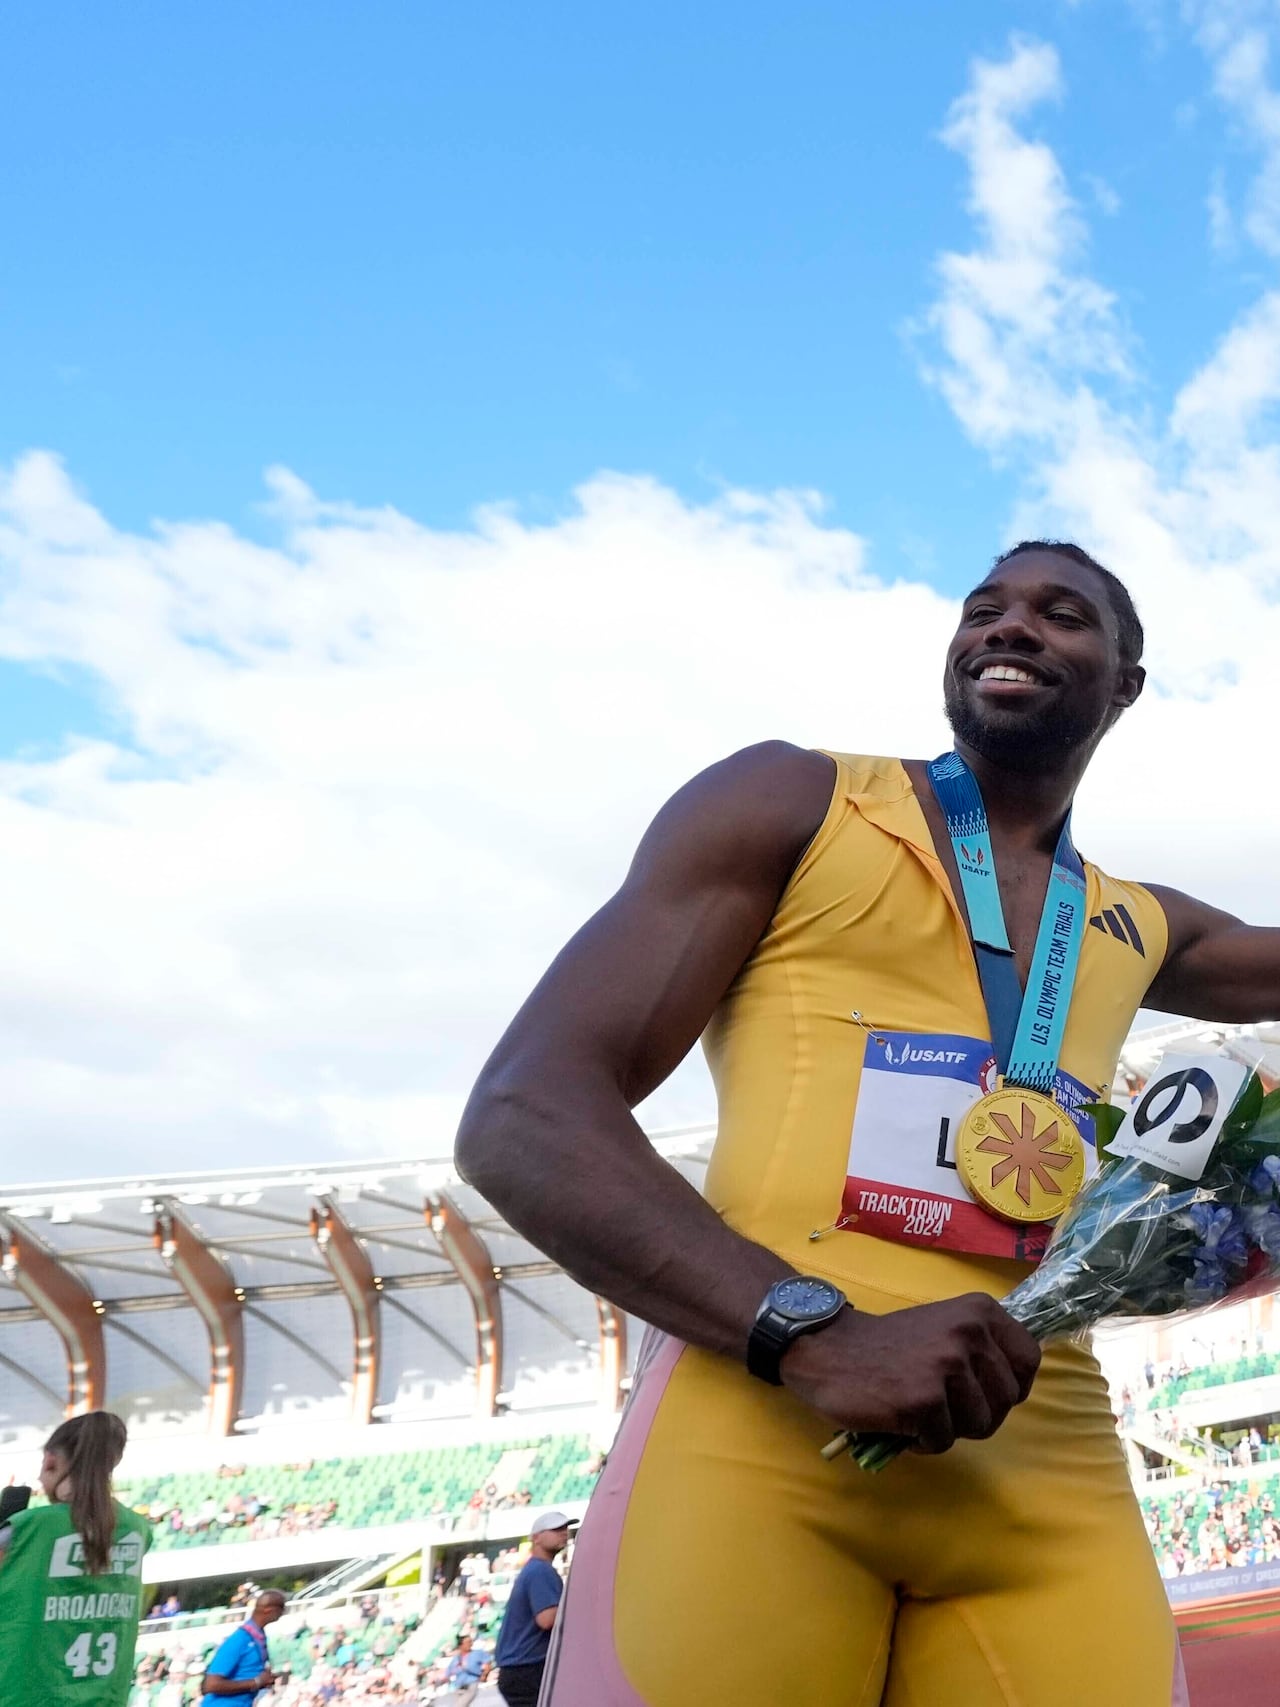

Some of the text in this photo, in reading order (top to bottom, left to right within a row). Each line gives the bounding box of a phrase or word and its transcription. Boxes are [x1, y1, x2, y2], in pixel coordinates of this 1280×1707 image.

[961, 863, 991, 877] USATF
[1031, 901, 1075, 1046] U.S. OLYMPIC TEAM TRIALS
[909, 1049, 968, 1064] USATF
[859, 1191, 953, 1222] TRACKTOWN
[902, 1214, 944, 1237] 2024
[64, 1632, 118, 1678] 43
